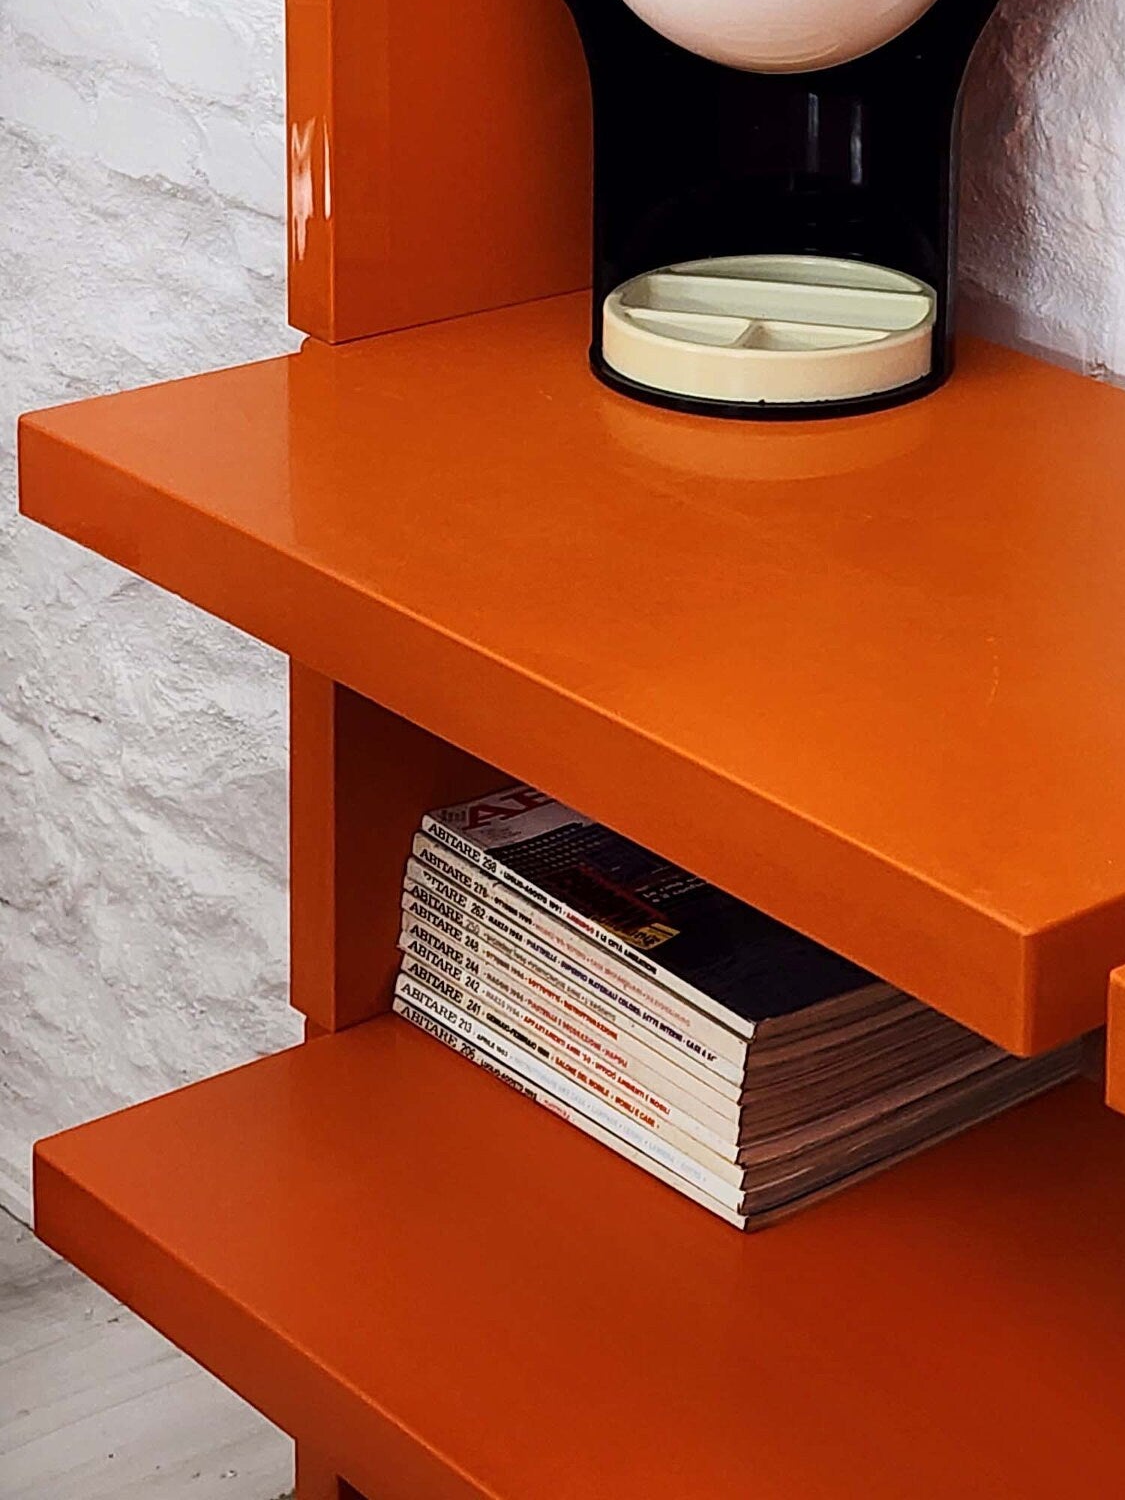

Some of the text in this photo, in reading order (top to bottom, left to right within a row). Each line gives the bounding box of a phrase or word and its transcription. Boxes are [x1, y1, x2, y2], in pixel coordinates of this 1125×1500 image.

[428, 823, 480, 862] ABITARE
[421, 848, 472, 887] ABITARE
[410, 885, 463, 924] ABITARE
[411, 901, 463, 940] ABITARE
[472, 903, 485, 918] 262
[409, 940, 462, 979] ABITARE
[466, 976, 479, 991] 242
[411, 925, 463, 963] ABITARE
[465, 958, 479, 974] 244
[401, 983, 457, 1024] ABITARE
[459, 1019, 471, 1033] 213
[409, 962, 463, 1002] ABITARE
[468, 999, 480, 1014] 241
[401, 1006, 457, 1047] ABITARE
